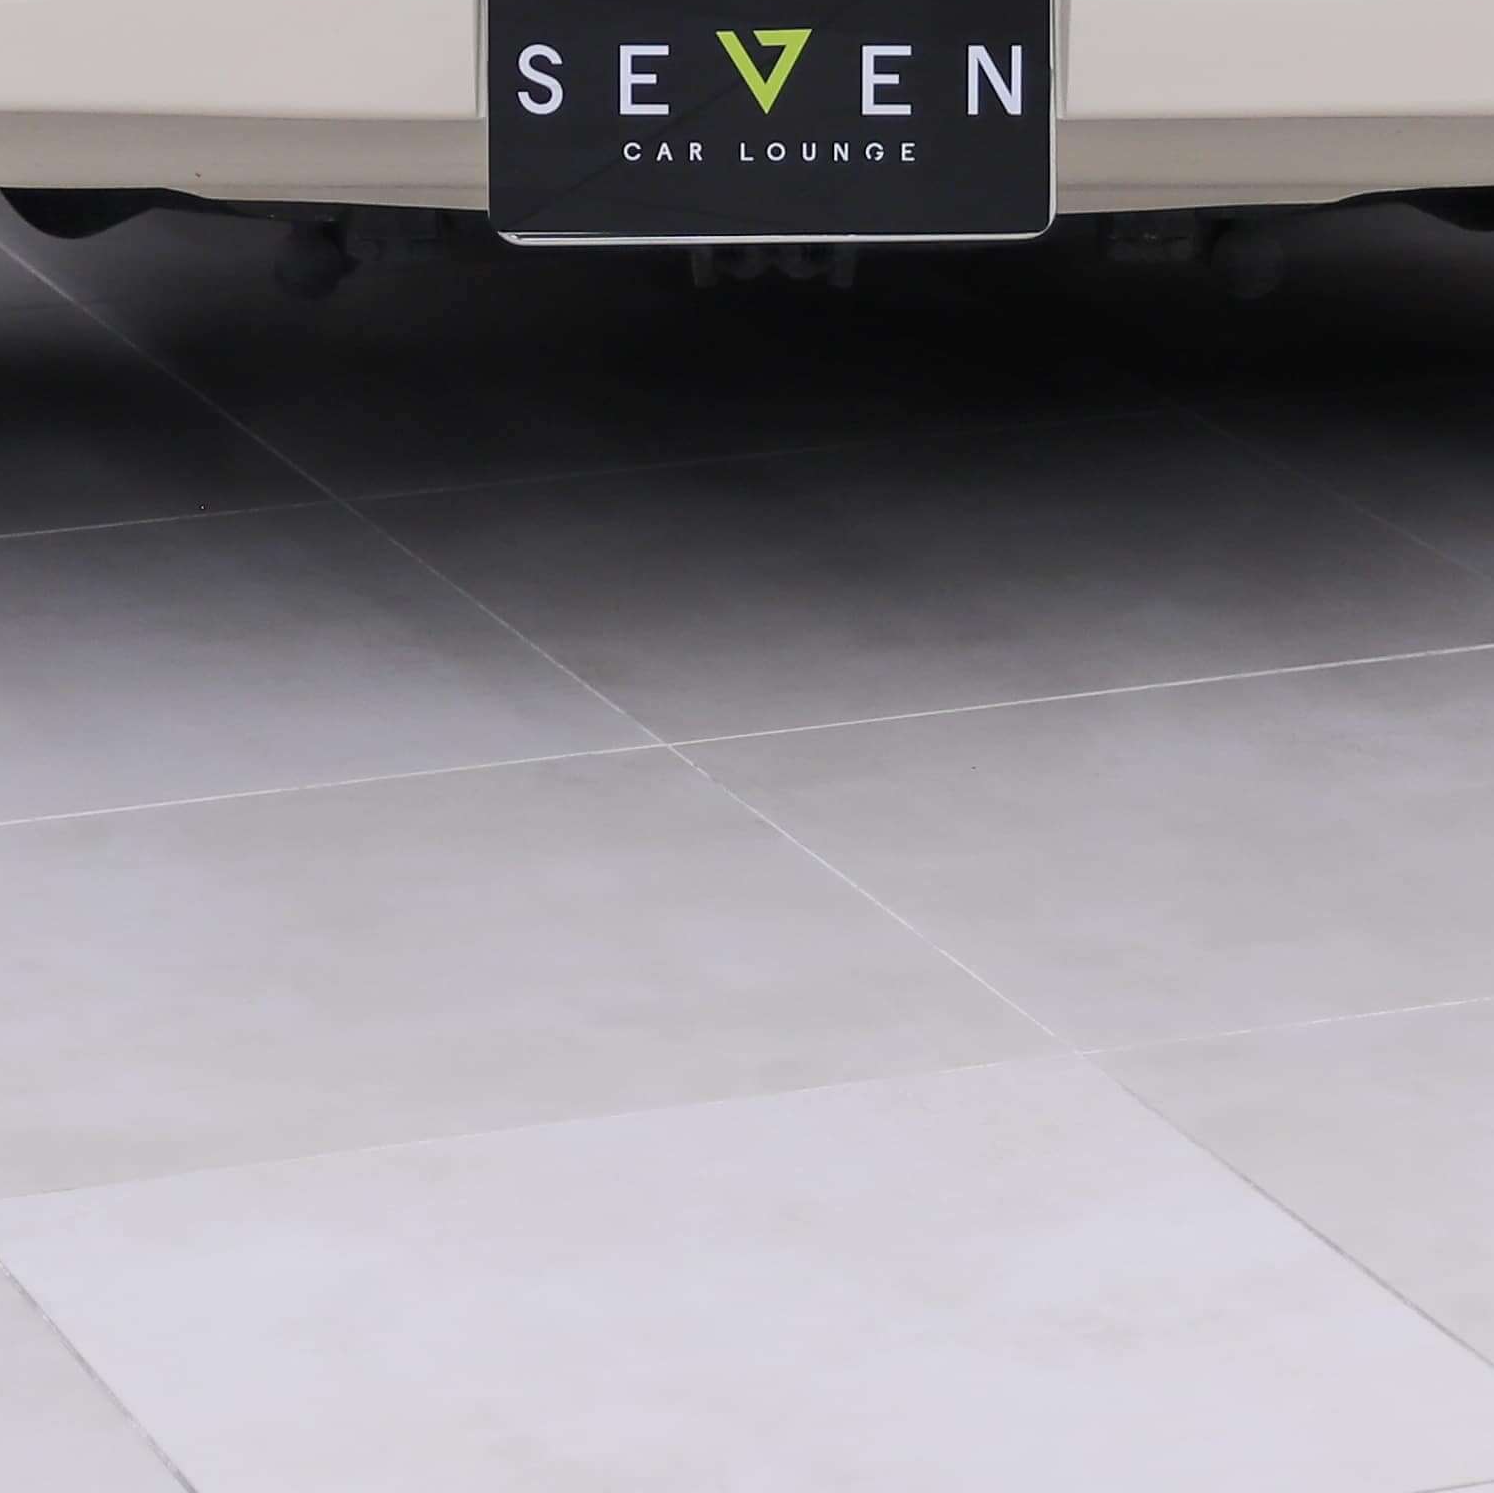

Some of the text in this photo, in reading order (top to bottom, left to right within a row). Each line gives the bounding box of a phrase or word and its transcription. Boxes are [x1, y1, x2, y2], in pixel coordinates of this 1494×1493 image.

[516, 28, 1023, 116] SEVEN
[622, 141, 917, 163] CAR LOUNGE
